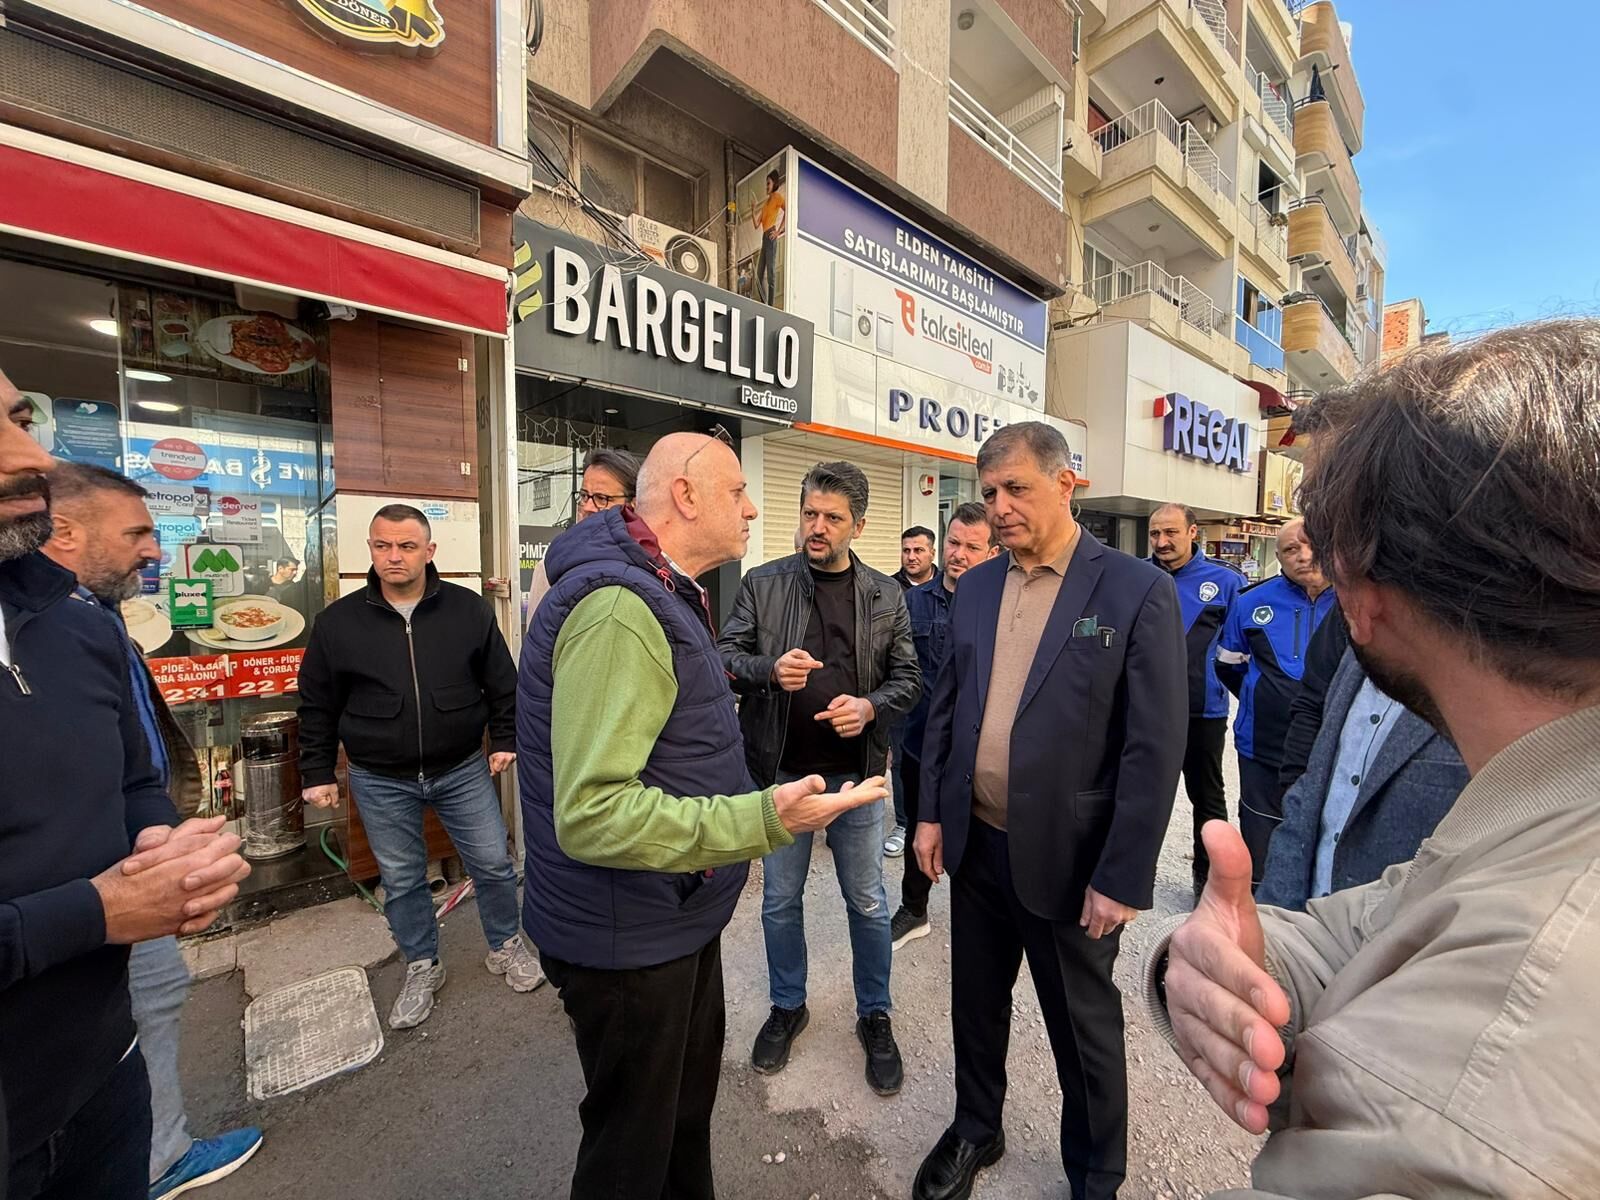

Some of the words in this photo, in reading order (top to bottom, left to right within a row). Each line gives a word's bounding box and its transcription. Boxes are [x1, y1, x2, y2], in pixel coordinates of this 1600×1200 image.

[338, 0, 391, 28] DÖNER
[896, 228, 940, 266] ELDEN
[943, 253, 994, 296] TAKSİTLİ
[844, 228, 949, 295] SATIŞLARIMIZ
[951, 284, 1024, 335] BAŞLAMIŞTIR
[553, 246, 800, 388] BARGELLO
[742, 384, 798, 413] Perfume
[161, 451, 196, 461] trendyol
[146, 491, 194, 503] etropol
[157, 522, 195, 533] tropol
[243, 655, 274, 667] DÖNER
[280, 653, 301, 665] PİDE
[161, 662, 185, 674] PİDE
[262, 664, 293, 677] ÇORBA
[154, 674, 175, 684] RBA
[177, 671, 217, 682] SALONU
